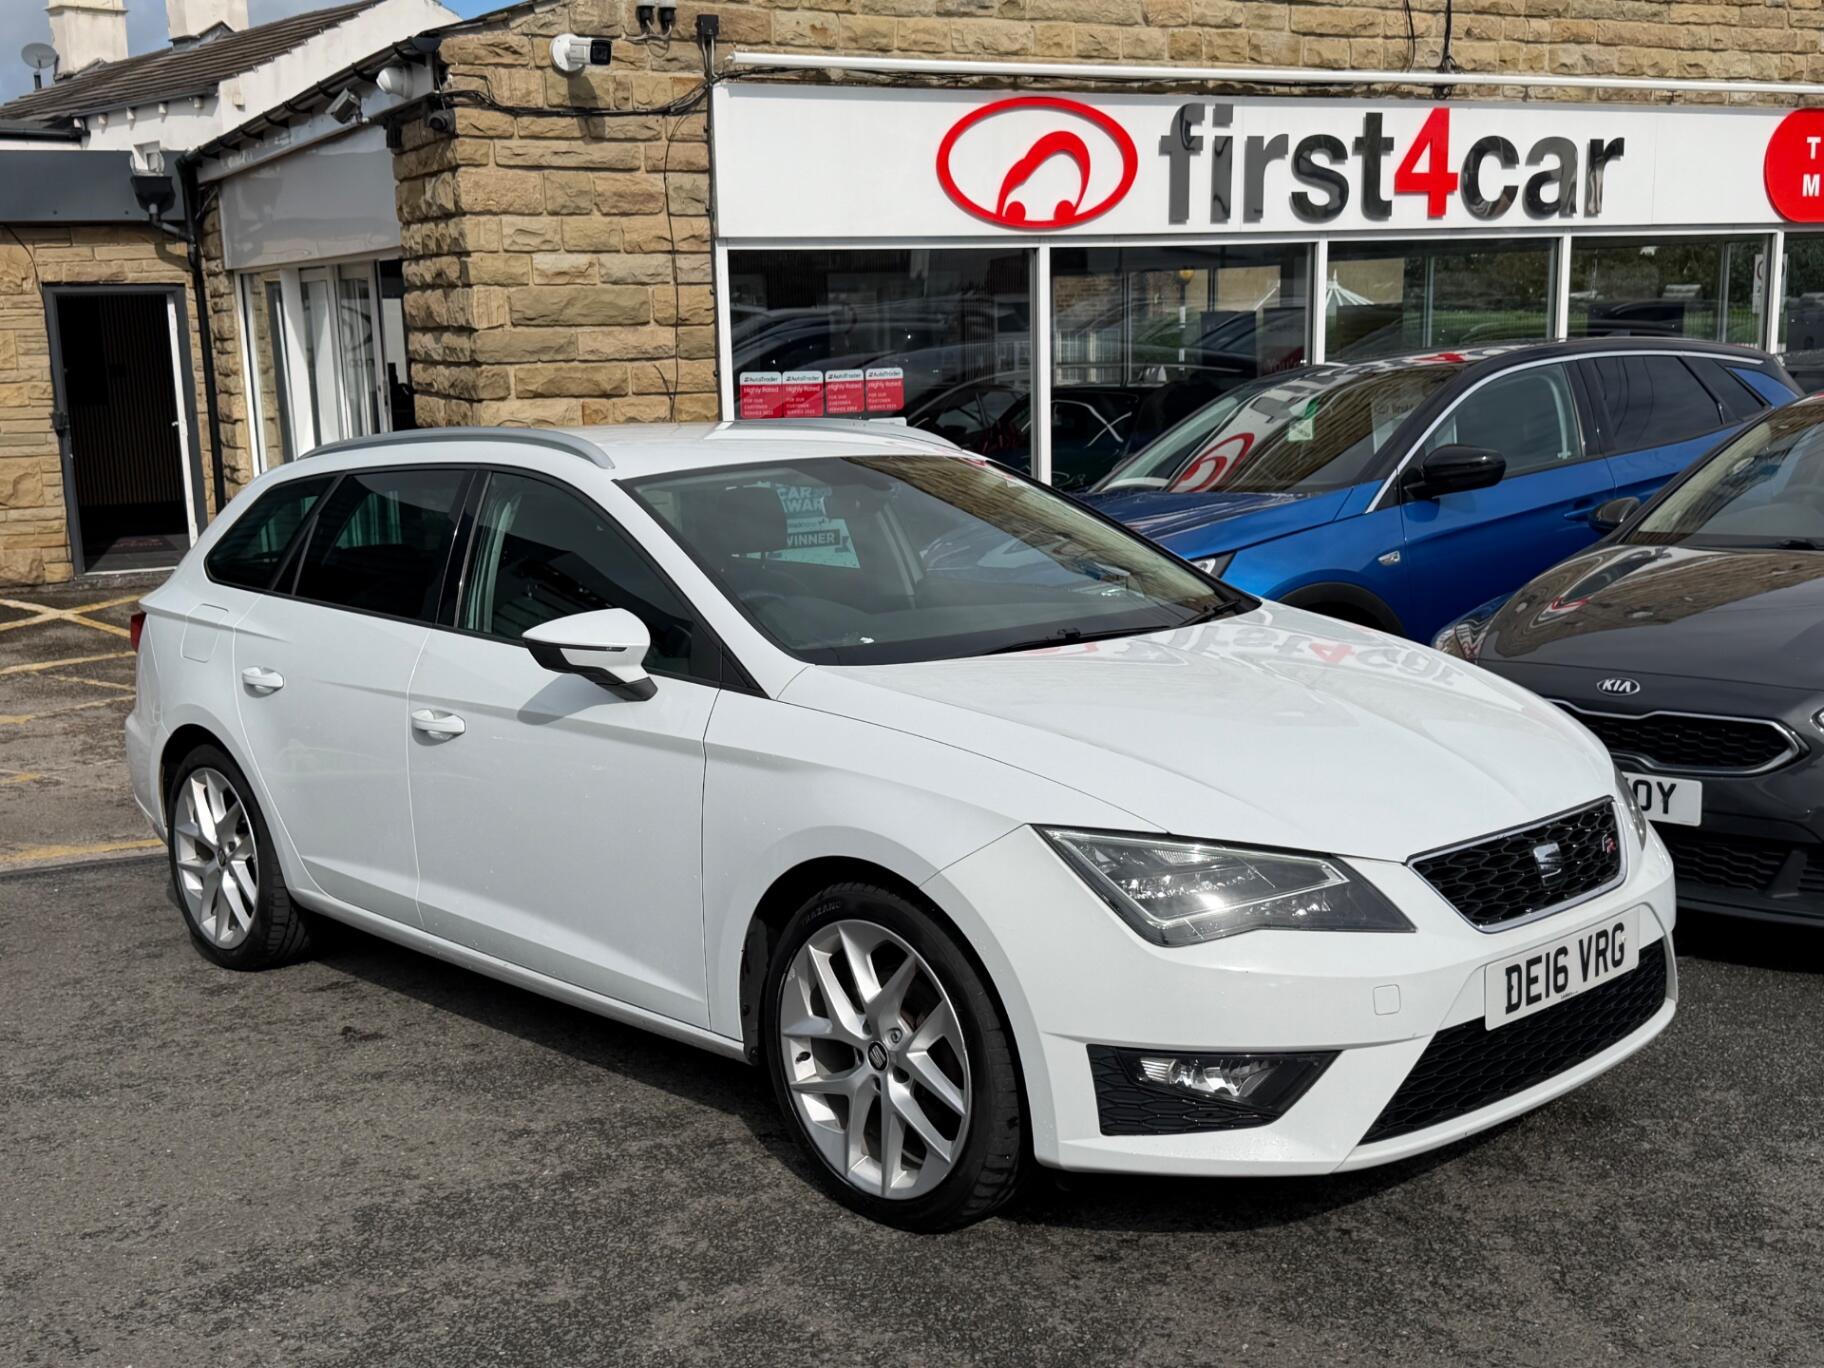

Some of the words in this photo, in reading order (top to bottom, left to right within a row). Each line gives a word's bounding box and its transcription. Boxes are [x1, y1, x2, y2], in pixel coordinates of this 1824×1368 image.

[1159, 102, 1625, 224] first4car
[1602, 680, 1631, 693] KIA
[1626, 778, 1677, 815] OY
[1505, 946, 1568, 1015] DE16
[1579, 922, 1625, 982] VRG
